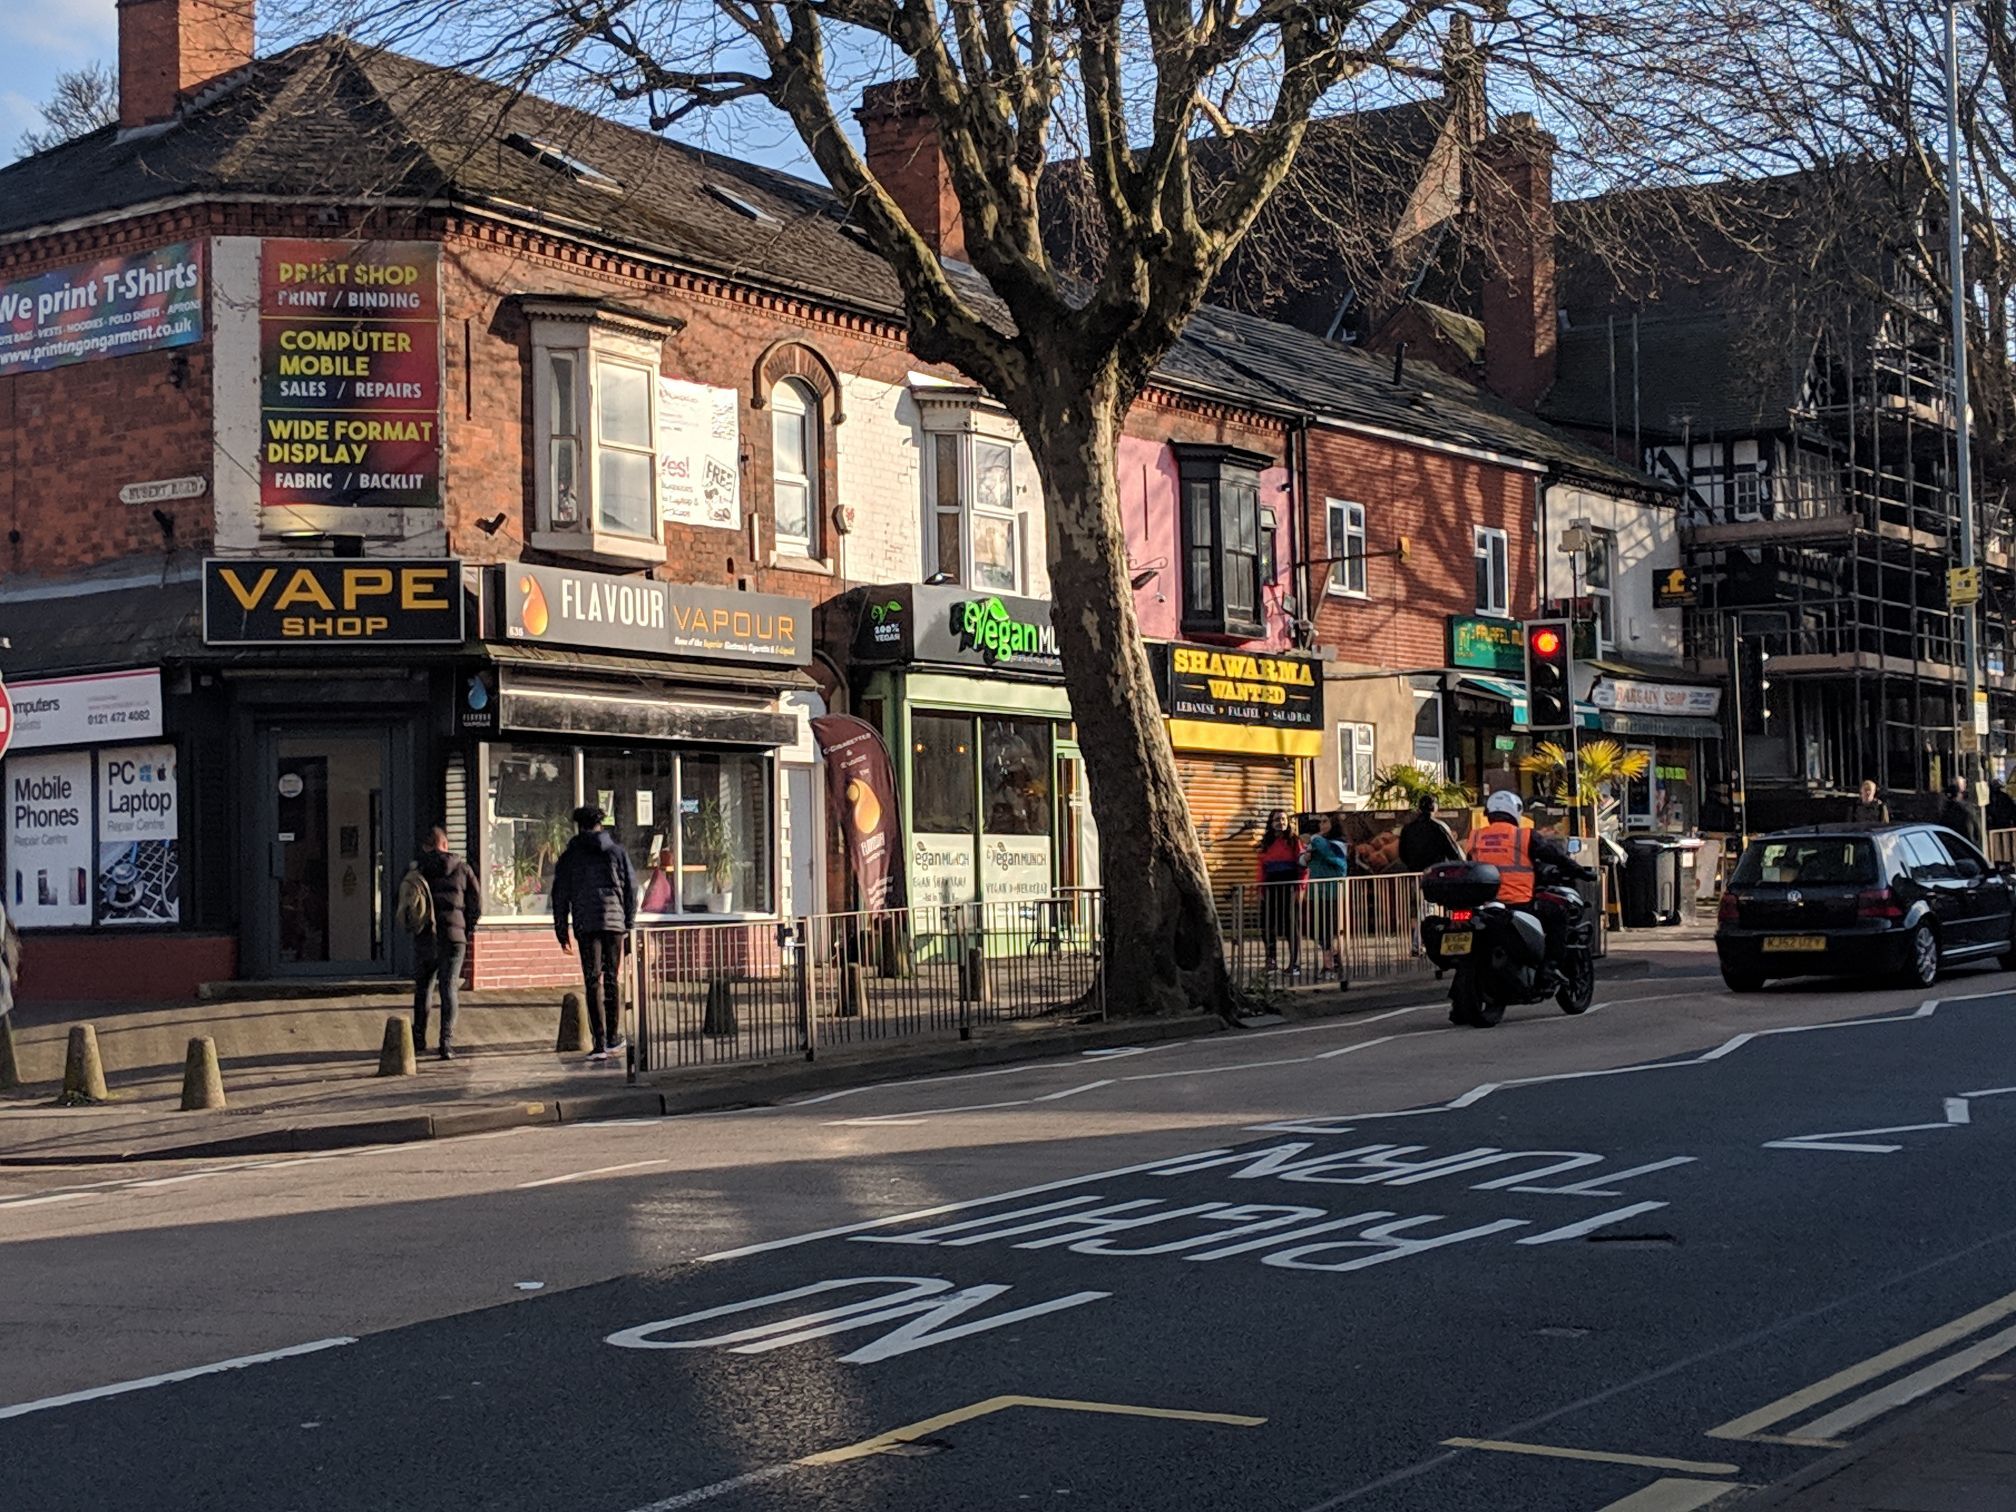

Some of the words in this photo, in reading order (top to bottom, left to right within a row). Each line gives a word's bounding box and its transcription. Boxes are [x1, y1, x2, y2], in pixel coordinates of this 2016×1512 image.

[279, 262, 349, 284] PRINT
[354, 263, 418, 286] SHOP
[0, 293, 33, 324] We
[38, 280, 98, 325] print
[104, 262, 198, 303] T-Shirts
[278, 290, 327, 306] PRINT
[348, 291, 420, 308] BINDING
[109, 312, 132, 326] POLO
[279, 329, 412, 353] COMPUTER
[279, 354, 370, 377] MOBILE
[279, 380, 327, 397] SALES
[355, 381, 422, 399] REPAIRS
[267, 418, 329, 441] WIDE
[334, 420, 433, 442] FORMAT
[267, 443, 368, 464] DISPLAY
[275, 471, 332, 489] FABRIC
[359, 473, 424, 490] BACKLIT
[218, 568, 449, 611] VAPE
[561, 578, 665, 629] FLAVOUR
[673, 605, 794, 642] VAPOUR
[281, 616, 388, 637] SHOP
[874, 623, 900, 635] 100%
[1173, 648, 1315, 687] SHAWARMA
[1207, 679, 1286, 705] WANTED
[87, 710, 107, 726] 0121
[110, 710, 127, 724] 472
[1176, 701, 1216, 715] LEBANESE
[1228, 705, 1261, 718] FALAFEL
[1272, 709, 1296, 722] SALAD
[1296, 711, 1312, 723] BAR
[108, 760, 135, 786] PC
[15, 775, 72, 802] Mobile
[109, 788, 172, 818] Laptop
[15, 804, 79, 829] Phones
[107, 820, 135, 833] Repair
[136, 818, 165, 831] Centre
[1149, 1142, 1699, 1196] TURN
[846, 1196, 1532, 1272] RIGHT
[603, 1276, 1113, 1364] NO
